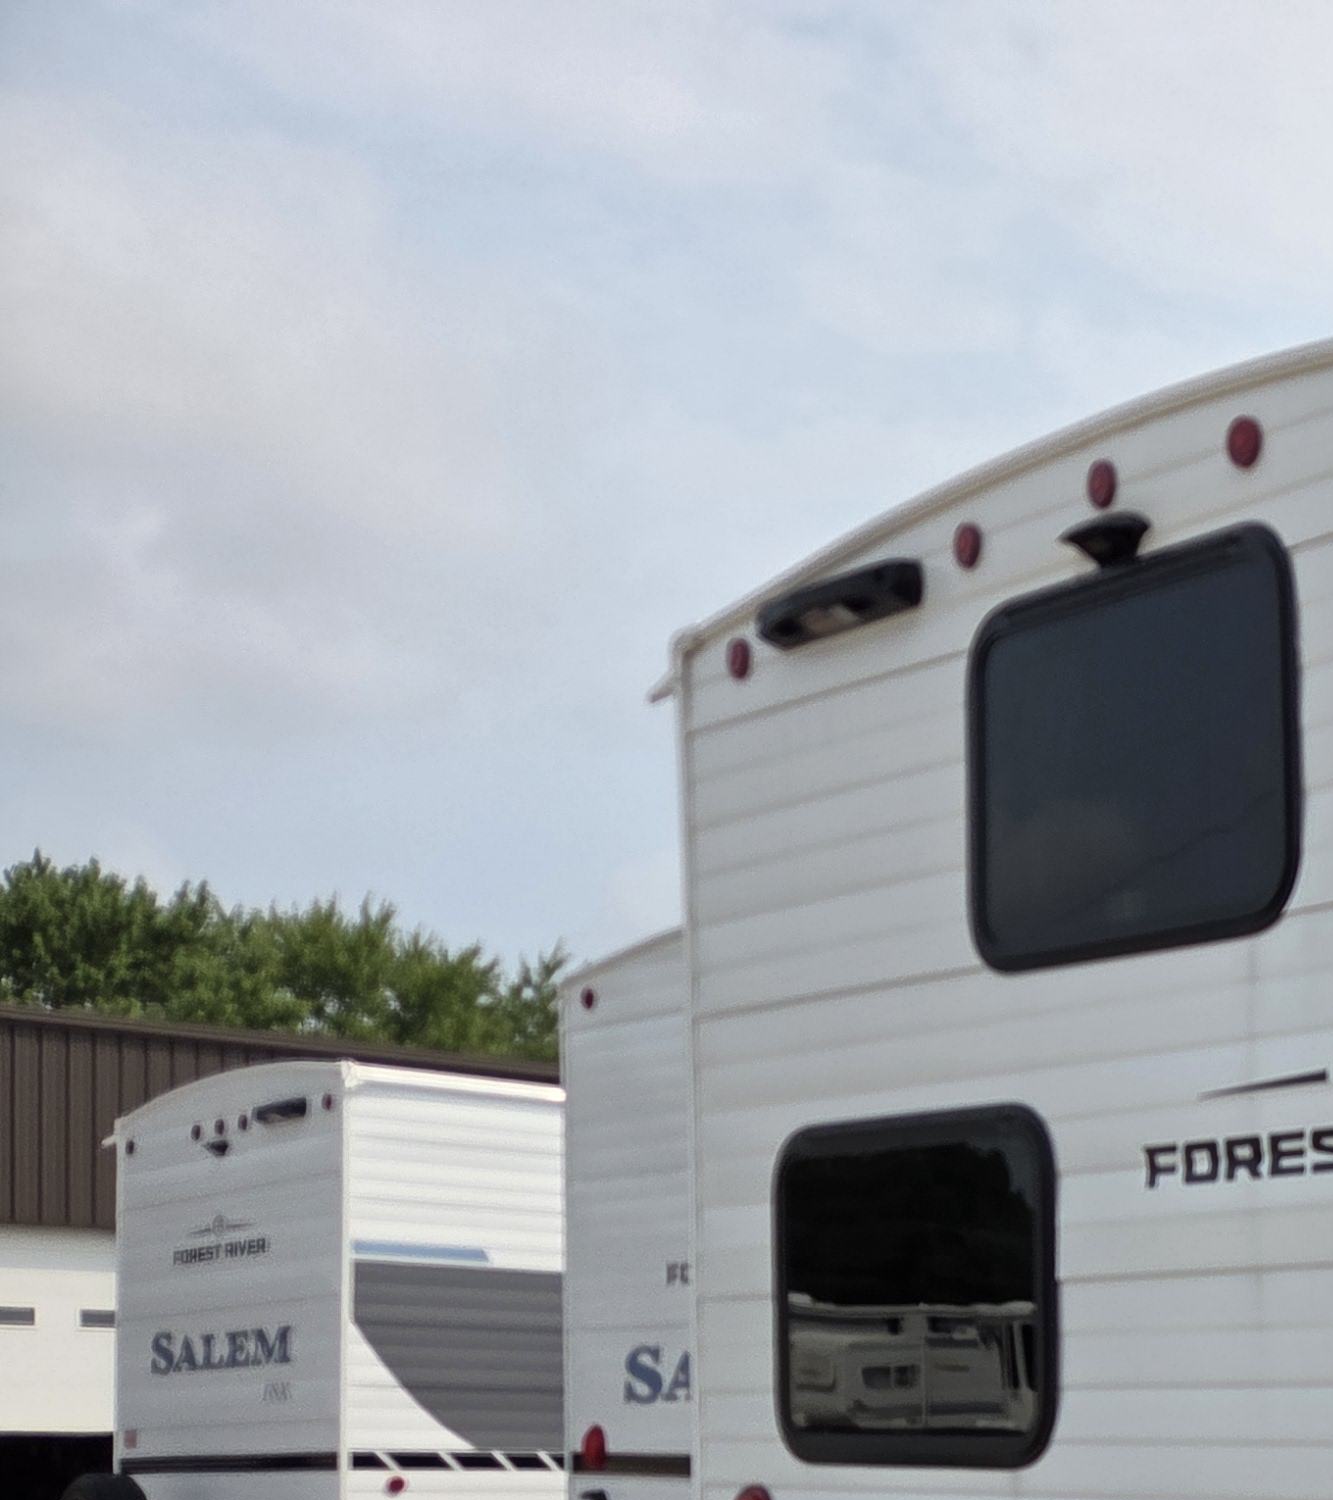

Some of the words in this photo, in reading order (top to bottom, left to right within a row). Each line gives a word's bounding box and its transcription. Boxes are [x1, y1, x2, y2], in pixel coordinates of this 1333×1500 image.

[173, 1243, 222, 1266] FOREST
[224, 1237, 267, 1258] RIVER
[151, 1325, 292, 1375] SALEM
